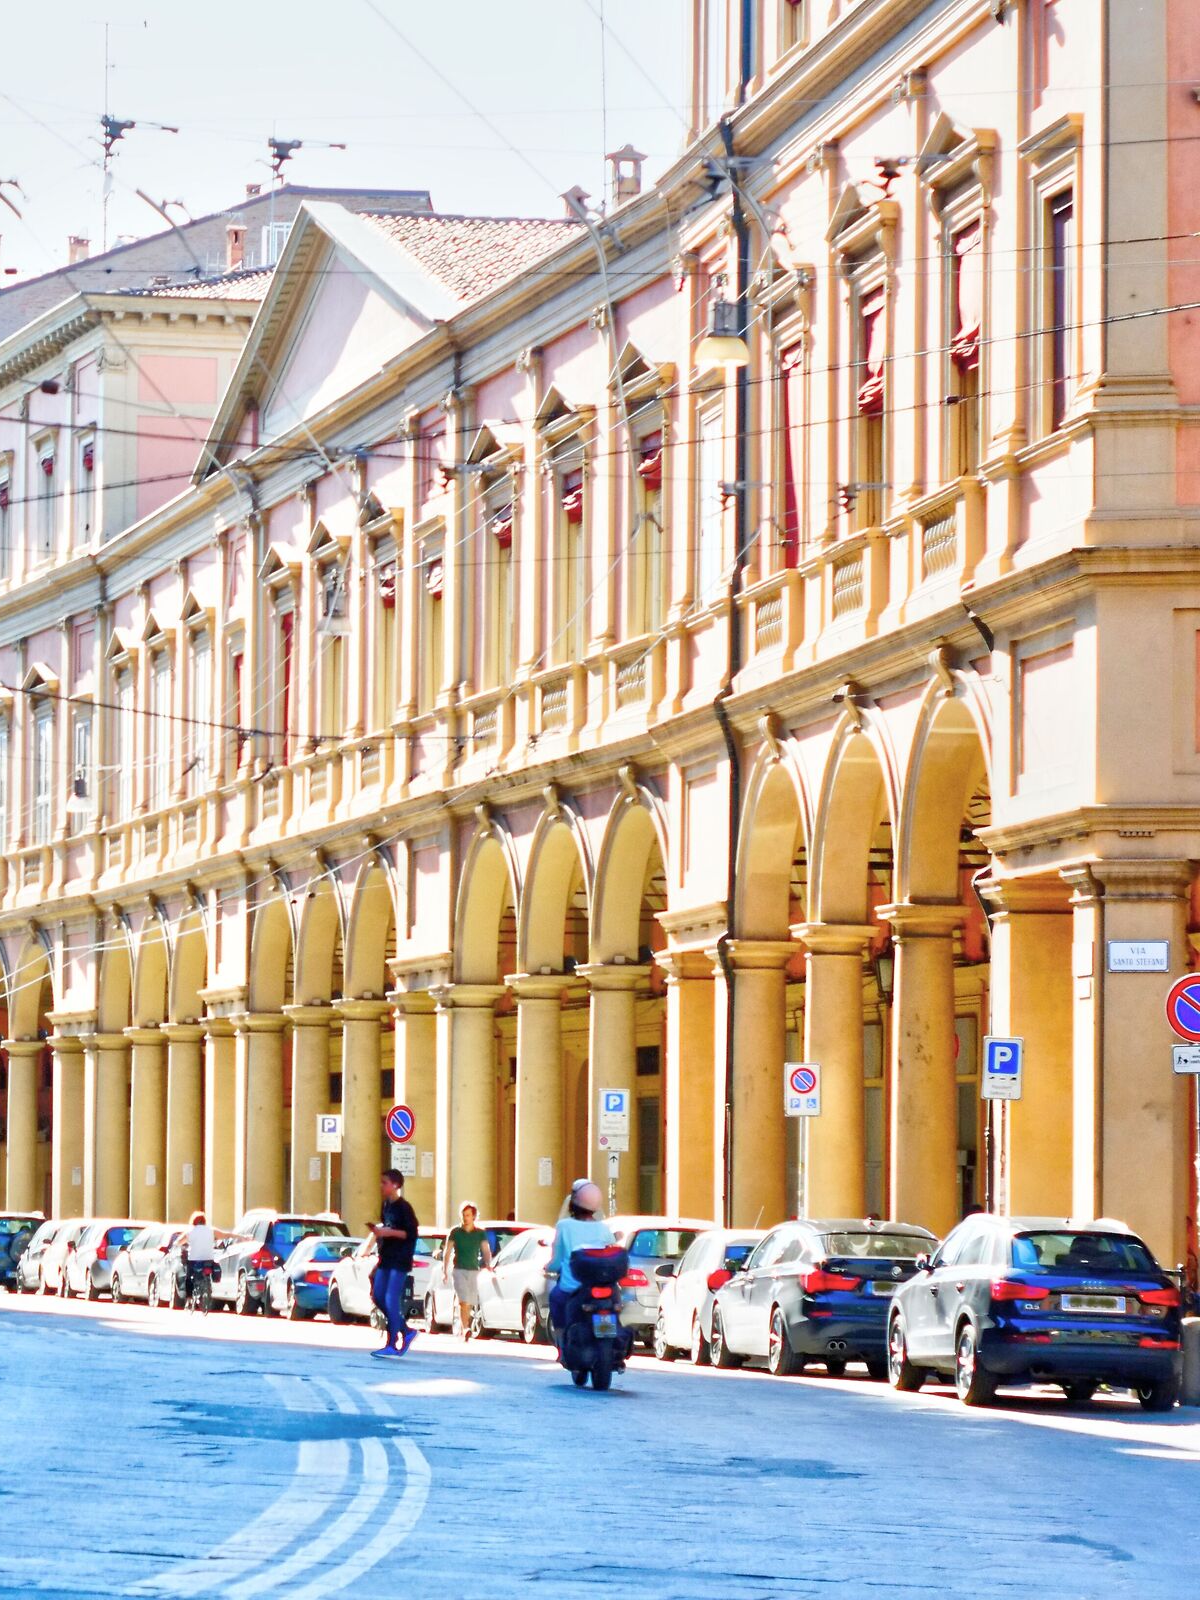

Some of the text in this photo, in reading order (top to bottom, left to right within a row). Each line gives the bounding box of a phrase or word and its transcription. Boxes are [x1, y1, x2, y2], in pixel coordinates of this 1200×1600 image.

[1113, 958, 1165, 966] SANTO STEFANO
[994, 1046, 1013, 1070] P
[608, 1095, 621, 1110] P
[792, 1099, 800, 1108] P
[324, 1118, 336, 1133] P
